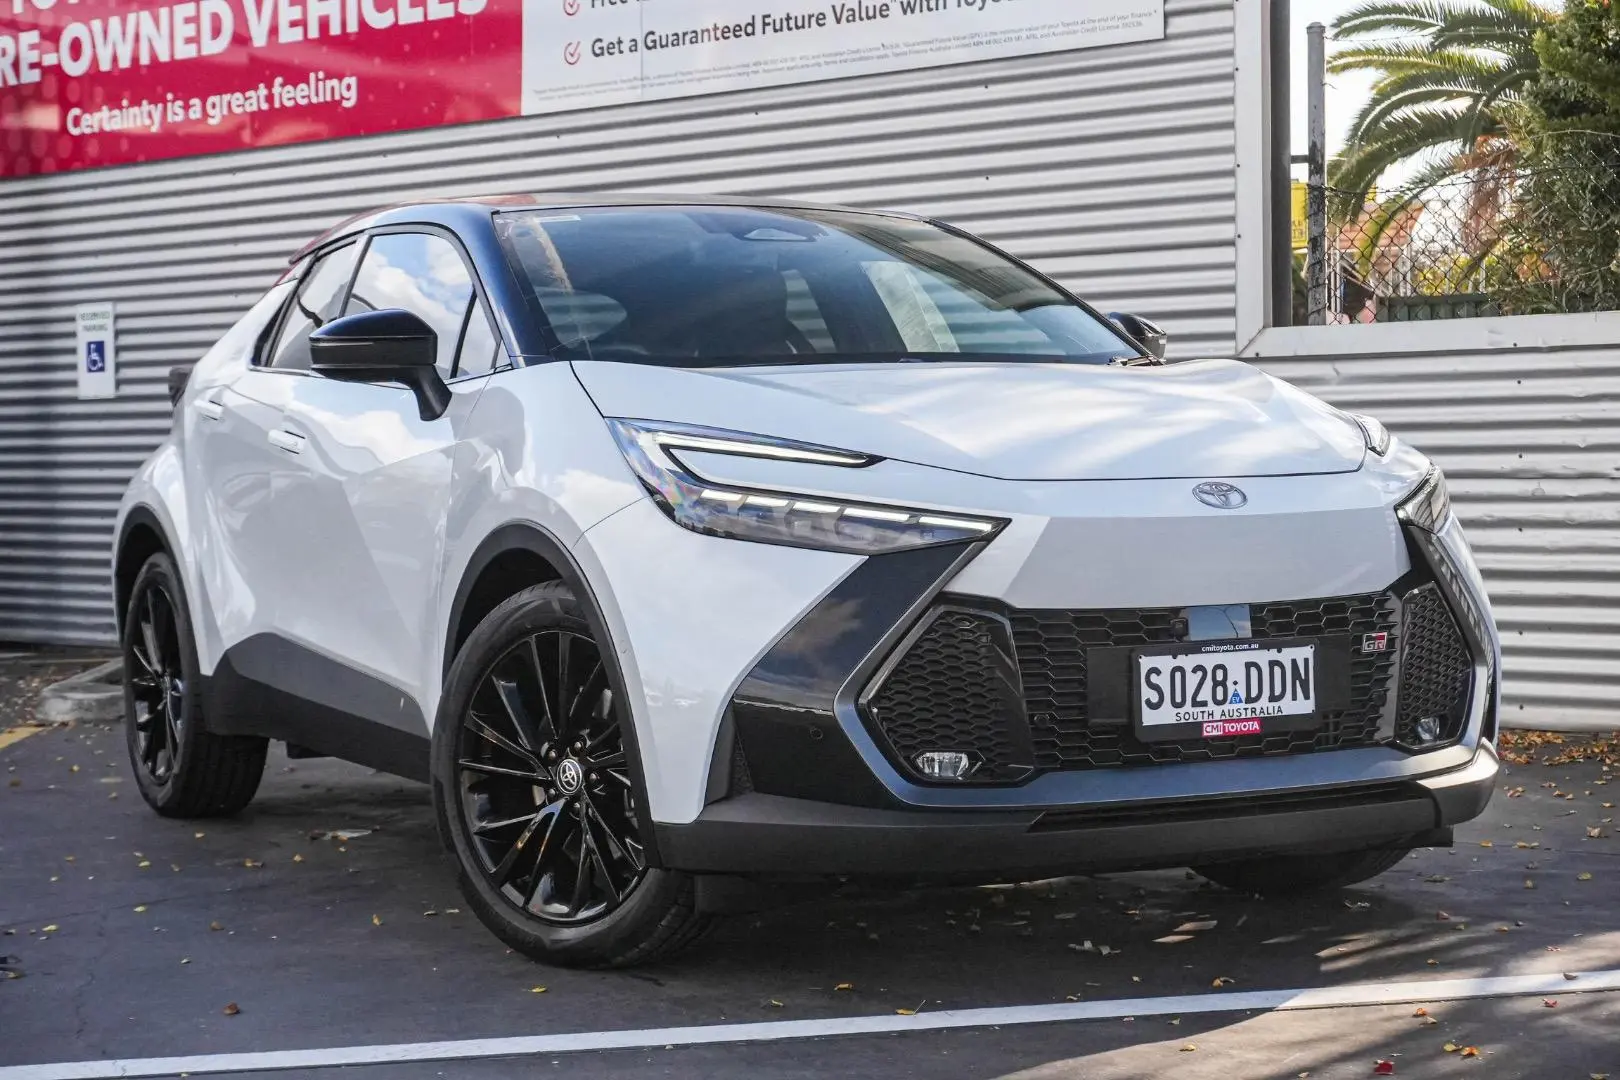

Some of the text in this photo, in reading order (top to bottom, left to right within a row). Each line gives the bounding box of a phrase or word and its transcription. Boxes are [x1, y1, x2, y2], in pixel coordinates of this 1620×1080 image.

[243, 0, 488, 48] VEHIC
[591, 36, 624, 58] Get
[629, 38, 639, 53] a
[644, 15, 756, 51] Guaranteed
[762, 12, 827, 35] Future
[66, 70, 357, 136] Certainty is a great feeling
[1202, 643, 1259, 653] cmitoyota.com.au
[1175, 705, 1284, 722] SOUTH AUSTRALIA
[1224, 721, 1260, 733] TOYOTA
